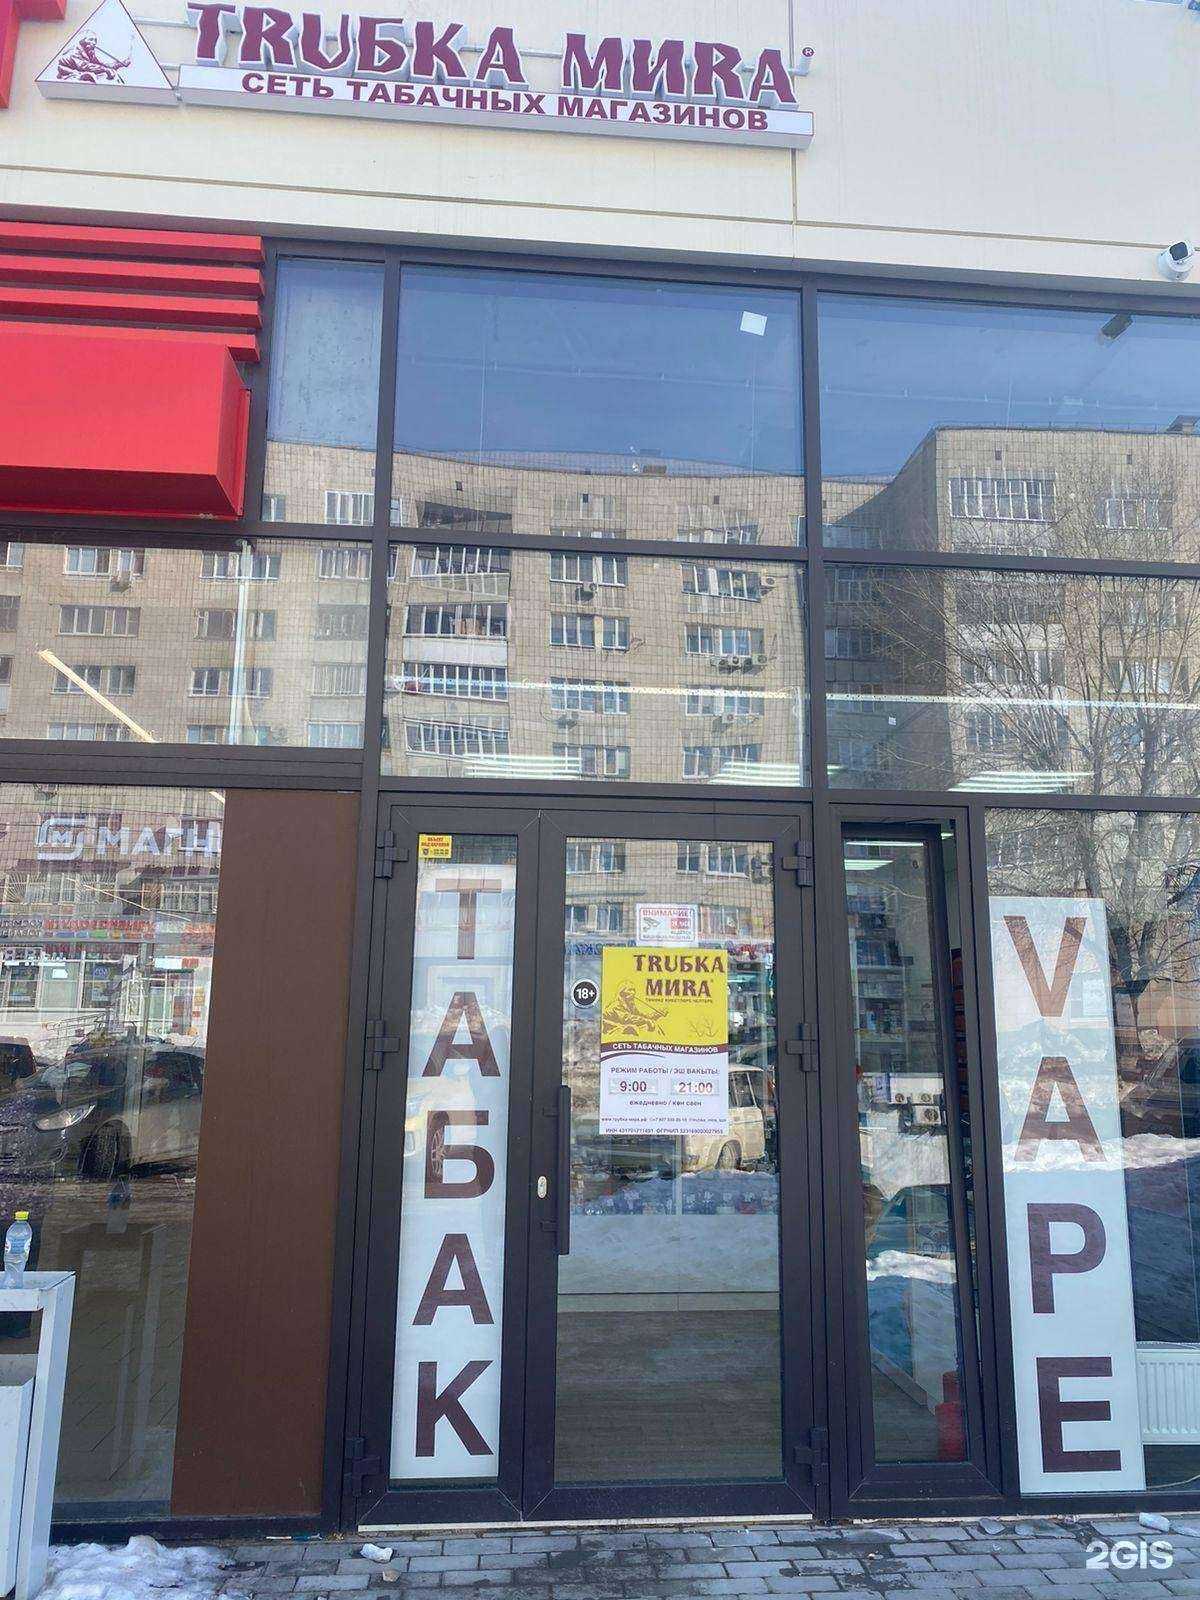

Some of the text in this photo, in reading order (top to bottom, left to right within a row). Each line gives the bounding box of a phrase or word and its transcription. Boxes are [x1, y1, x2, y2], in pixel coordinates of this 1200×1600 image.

[241, 72, 769, 131] СЕТЬ ТАБАЧНЫХ МАГАЗИНОВ
[576, 987, 595, 999] 18+
[634, 1043, 673, 1052] ТАБАЧНЫХ
[674, 1045, 719, 1053] МАГАЗИНОВ
[620, 1081, 713, 1093] 9:00 21:00
[412, 878, 502, 1457] ТАБАК
[1003, 915, 1122, 1473] VAPE
